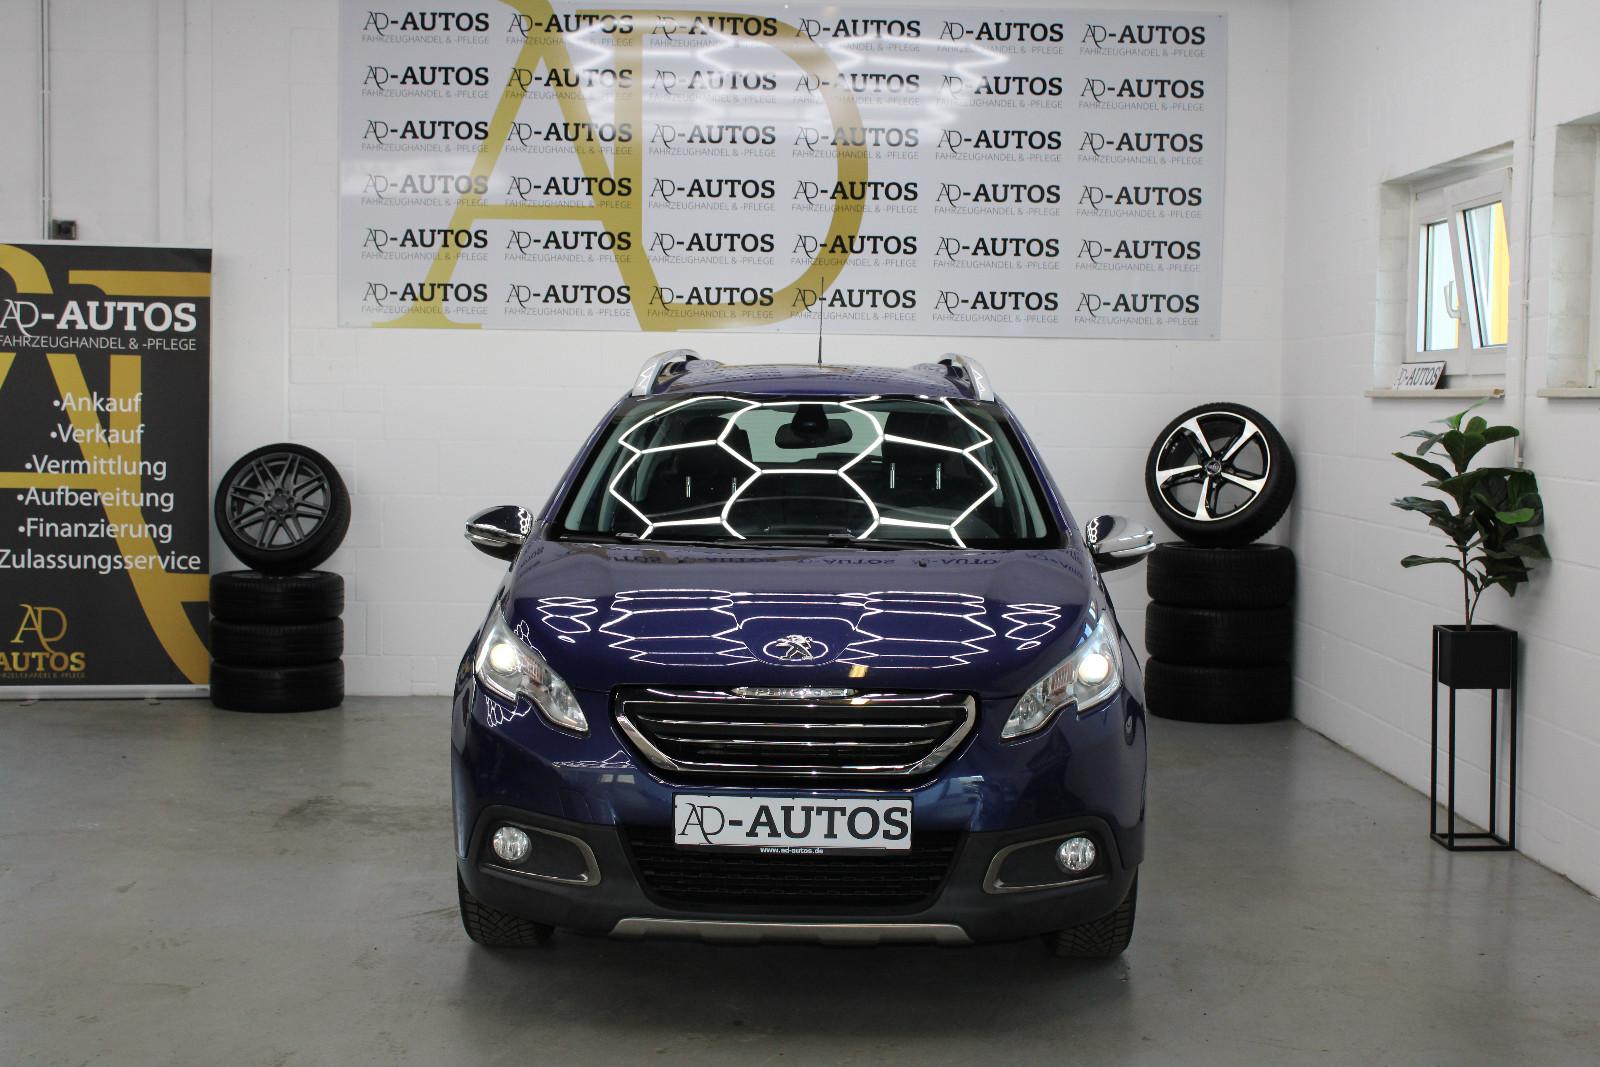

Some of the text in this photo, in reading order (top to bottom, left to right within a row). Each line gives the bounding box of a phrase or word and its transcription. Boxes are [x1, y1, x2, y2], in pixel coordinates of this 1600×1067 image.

[362, 9, 489, 38] AD-AUTOS
[507, 12, 634, 40] AD-AUTOS
[651, 15, 777, 43] AD-AUTOS
[794, 17, 921, 46] AD-AUTOS
[938, 20, 1064, 48] AD-AUTOS
[1081, 23, 1206, 51] AD-AUTOS
[361, 33, 442, 43] FAHRZEUGHANDEL
[1079, 46, 1160, 57] FAHRZEUGHANDEL
[362, 64, 489, 92] AD-AUTOS
[1079, 77, 1205, 105] AD-AUTOS
[361, 88, 442, 98] FAHRZEUGHANDEL
[1078, 101, 1158, 111] FAHRZEUGHANDEL
[362, 118, 489, 147] AD-AUTOS
[506, 121, 633, 149] AD-AUTOS
[650, 123, 776, 152] AD-AUTOS
[793, 126, 919, 154] AD-AUTOS
[936, 128, 1062, 157] AD-AUTOS
[1078, 131, 1204, 159] AD-AUTOS
[360, 142, 442, 152] FAHRZEUGHANDEL
[505, 145, 586, 155] FAHRZEUGHANDEL
[648, 147, 729, 157] FAHRZEUGHANDEL
[792, 150, 872, 160] FAHRZEUGHANDEL
[934, 152, 1015, 162] FAHRZEUGHANDEL
[1077, 155, 1157, 165] FAHRZEUGHANDEL
[362, 172, 489, 201] AD-AUTOS
[506, 175, 632, 203] AD-AUTOS
[649, 177, 775, 206] AD-AUTOS
[792, 180, 918, 208] AD-AUTOS
[935, 182, 1061, 210] AD-AUTOS
[1077, 185, 1203, 213] AD-AUTOS
[360, 196, 442, 206] FAHRZEUGHANDEL
[648, 201, 729, 211] FAHRZEUGHANDEL
[791, 204, 872, 214] FAHRZEUGHANDEL
[934, 206, 1014, 216] FAHRZEUGHANDEL
[1076, 208, 1156, 218] FAHRZEUGHANDEL
[360, 250, 441, 260] FAHRZEUGHANDEL
[362, 227, 488, 255] AD-AUTOS
[505, 229, 632, 257] AD-AUTOS
[649, 231, 775, 259] AD-AUTOS
[792, 234, 917, 262] AD-AUTOS
[934, 236, 1060, 264] AD-AUTOS
[1076, 238, 1201, 266] AD-AUTOS
[504, 253, 585, 263] FAHRZEUGHANDEL
[647, 255, 728, 265] FAHRZEUGHANDEL
[790, 257, 871, 267] FAHRZEUGHANDEL
[933, 260, 1013, 270] FAHRZEUGHANDEL
[1075, 262, 1155, 272] FAHRZEUGHANDEL
[360, 304, 441, 314] FAHRZEUGHANDEL
[362, 281, 488, 309] AD-AUTOS
[505, 283, 631, 311] AD-AUTOS
[648, 285, 774, 313] AD-AUTOS
[791, 287, 917, 315] AD-AUTOS
[933, 290, 1059, 318] AD-AUTOS
[1075, 292, 1200, 320] AD-AUTOS
[0, 298, 198, 338] AD-AUTOS
[504, 307, 585, 316] FAHRZEUGHANDEL
[647, 309, 728, 319] FAHRZEUGHANDEL
[790, 311, 870, 321] FAHRZEUGHANDEL
[932, 313, 1012, 323] FAHRZEUGHANDEL
[1074, 316, 1154, 325] FAHRZEUGHANDEL
[128, 338, 139, 351] &
[142, 338, 197, 351] -PFLEGE
[60, 391, 143, 413] Ankauf
[57, 423, 146, 445] Verkauf
[31, 454, 168, 482] Vermittlung
[24, 485, 175, 513] Aufbereitung
[26, 517, 173, 544] Finanzierung
[0, 548, 202, 575] Zulassungsservice
[10, 603, 68, 655] AD
[677, 802, 909, 845] AD-AUTOS
[759, 846, 825, 855] www.ad-autos.de
